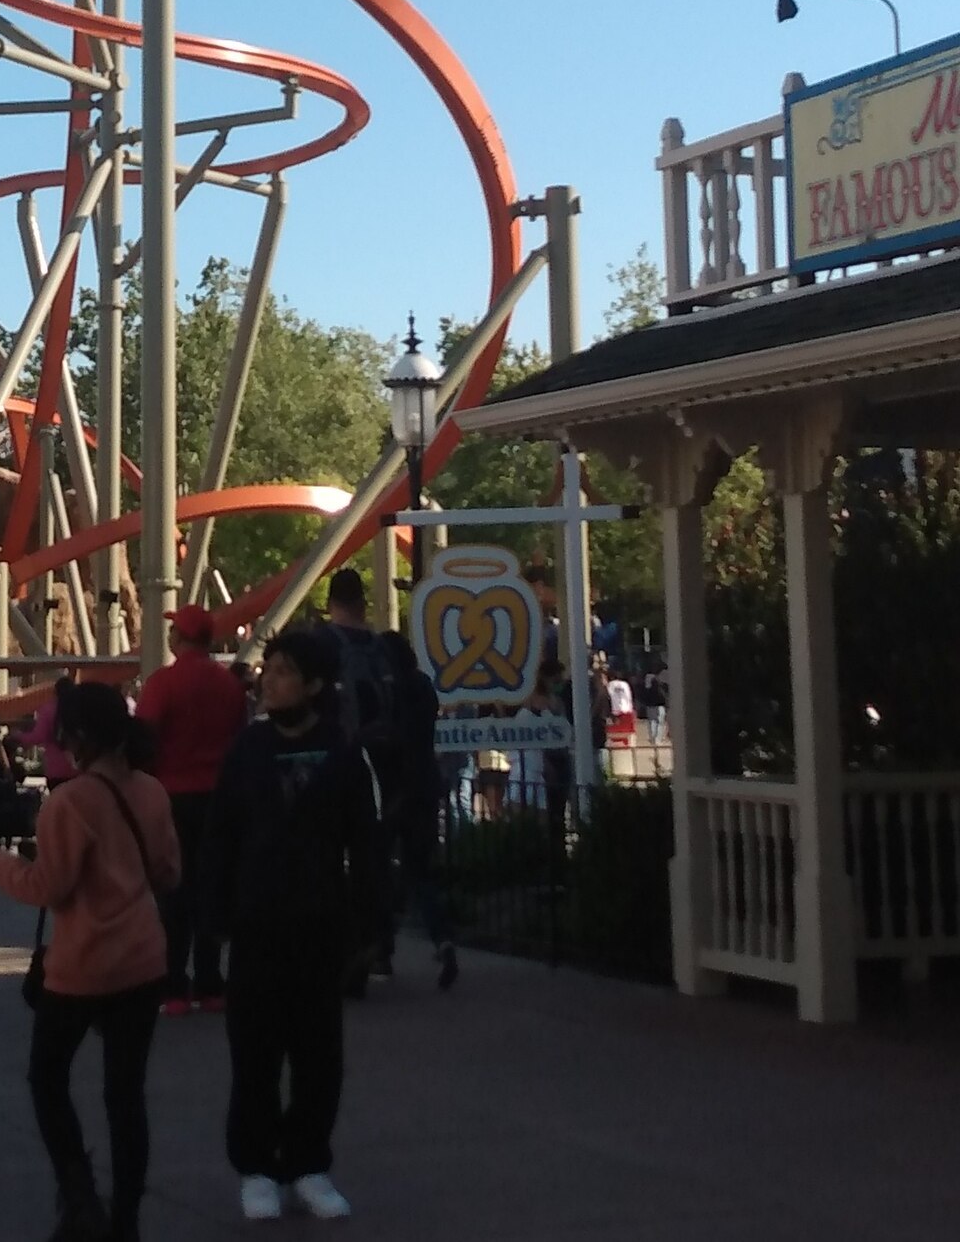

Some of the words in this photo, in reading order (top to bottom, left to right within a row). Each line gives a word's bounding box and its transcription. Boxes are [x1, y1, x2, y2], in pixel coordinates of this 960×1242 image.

[807, 145, 960, 248] FAMOUS
[435, 723, 483, 743] ntie
[486, 722, 565, 743] Anne's
